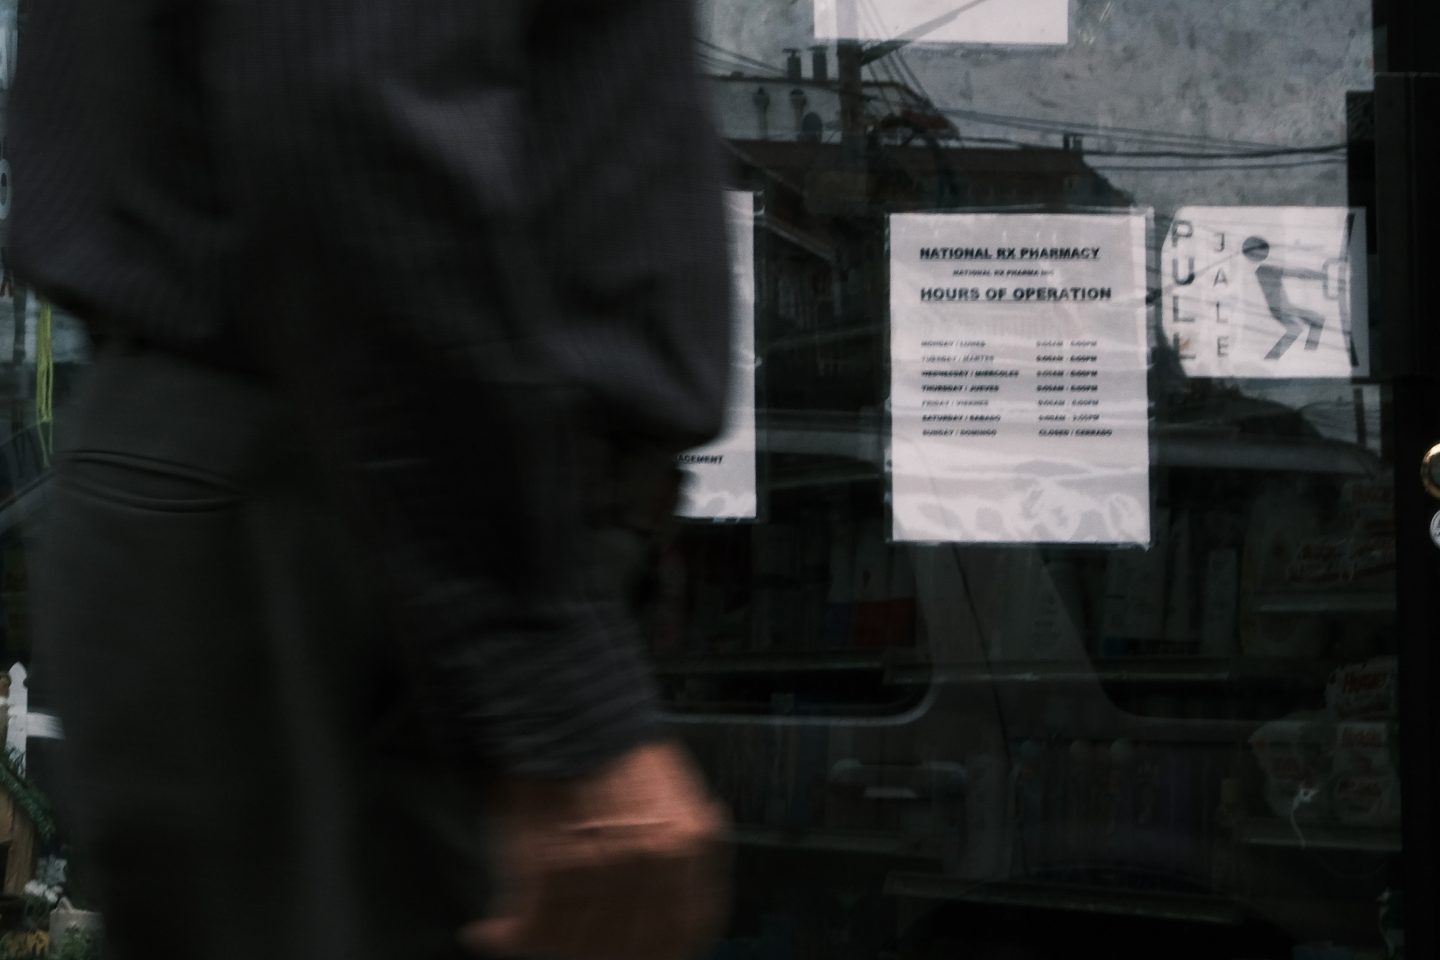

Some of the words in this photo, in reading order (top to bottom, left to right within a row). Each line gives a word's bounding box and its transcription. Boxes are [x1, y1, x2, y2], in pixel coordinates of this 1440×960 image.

[920, 247, 992, 260] NATIONAL
[996, 247, 1016, 260] RX
[1020, 246, 1100, 260] PHARMACY
[921, 287, 980, 301] HOURS
[985, 287, 1007, 301] OF
[1012, 287, 1111, 301] OPERATION
